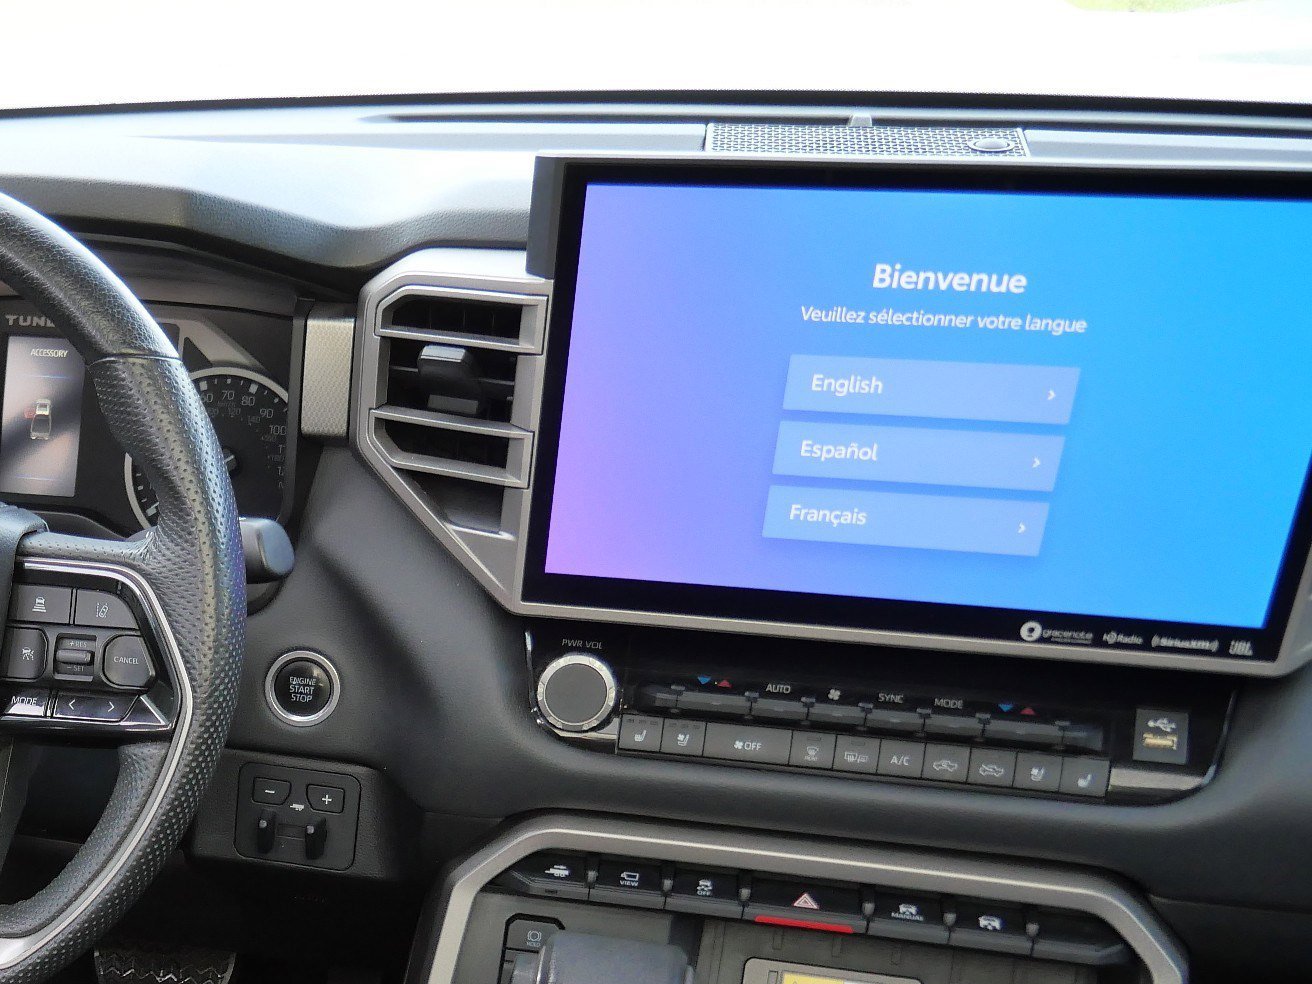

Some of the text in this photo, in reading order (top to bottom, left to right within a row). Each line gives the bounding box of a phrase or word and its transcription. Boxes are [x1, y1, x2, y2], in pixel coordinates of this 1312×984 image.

[872, 263, 1028, 294] Bienvenue
[800, 305, 1088, 336] Veuillez sélectionner votre langue
[30, 348, 68, 358] ACCESSORY
[811, 373, 884, 397] English
[221, 390, 235, 401] 70
[241, 396, 256, 406] 80
[259, 408, 274, 419] 90
[800, 440, 878, 462] Español
[789, 504, 868, 528] Français
[561, 638, 603, 650] PWR VOL
[113, 655, 139, 665] CANCEL
[289, 685, 315, 695] START
[765, 683, 791, 694] AUTO
[11, 695, 38, 706] MODE
[290, 693, 313, 703] STOP
[878, 693, 904, 704] SYNC
[934, 698, 964, 709] MODE
[744, 741, 762, 751] OFF
[890, 754, 909, 766] A/C
